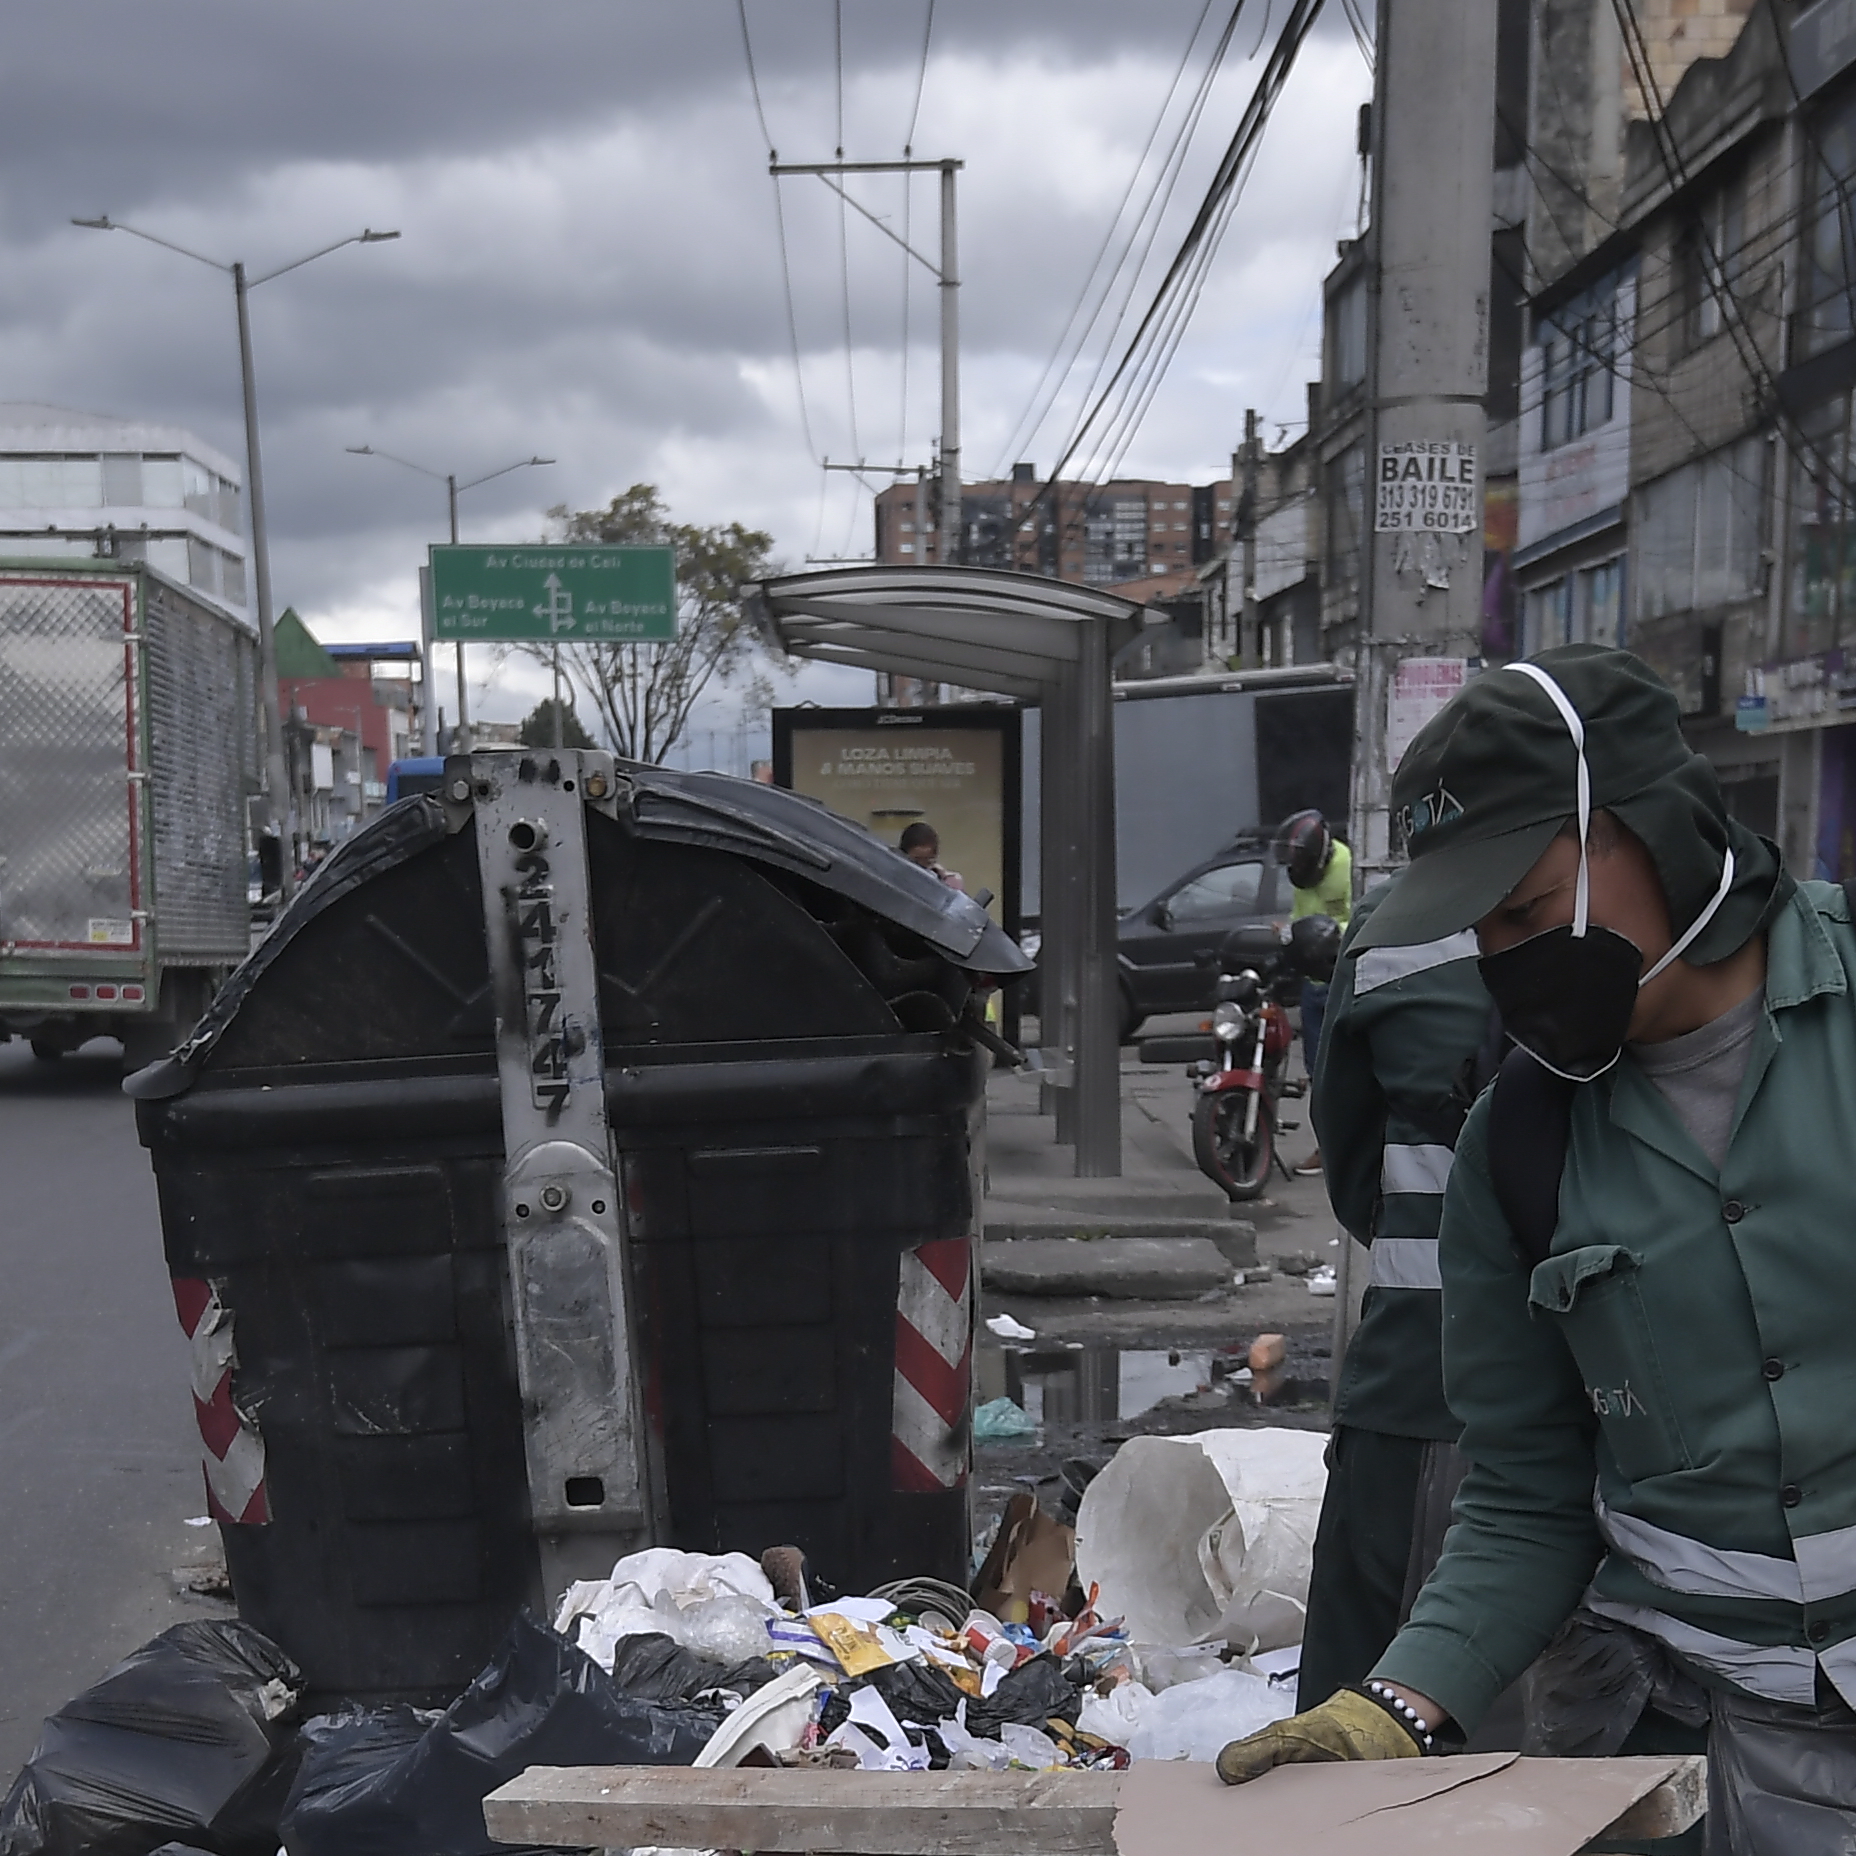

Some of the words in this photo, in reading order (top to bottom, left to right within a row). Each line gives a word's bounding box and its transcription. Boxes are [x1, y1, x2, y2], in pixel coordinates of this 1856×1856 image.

[1381, 456, 1475, 484] BAILE
[1380, 486, 1404, 510] 313
[1409, 485, 1437, 510] 319
[1380, 511, 1412, 528] 251
[1423, 511, 1472, 528] 6014
[486, 556, 508, 569] Av
[512, 555, 566, 569] Ciudad
[569, 555, 586, 568] de
[593, 555, 621, 569] Cali
[443, 596, 465, 609] Av
[585, 601, 607, 615] Av
[462, 614, 488, 628] Sur
[602, 620, 645, 634] Norte
[841, 748, 889, 760] LOZA
[895, 748, 953, 760] LIMPIA
[838, 762, 905, 775] MANOS
[909, 762, 975, 775] SUAVES
